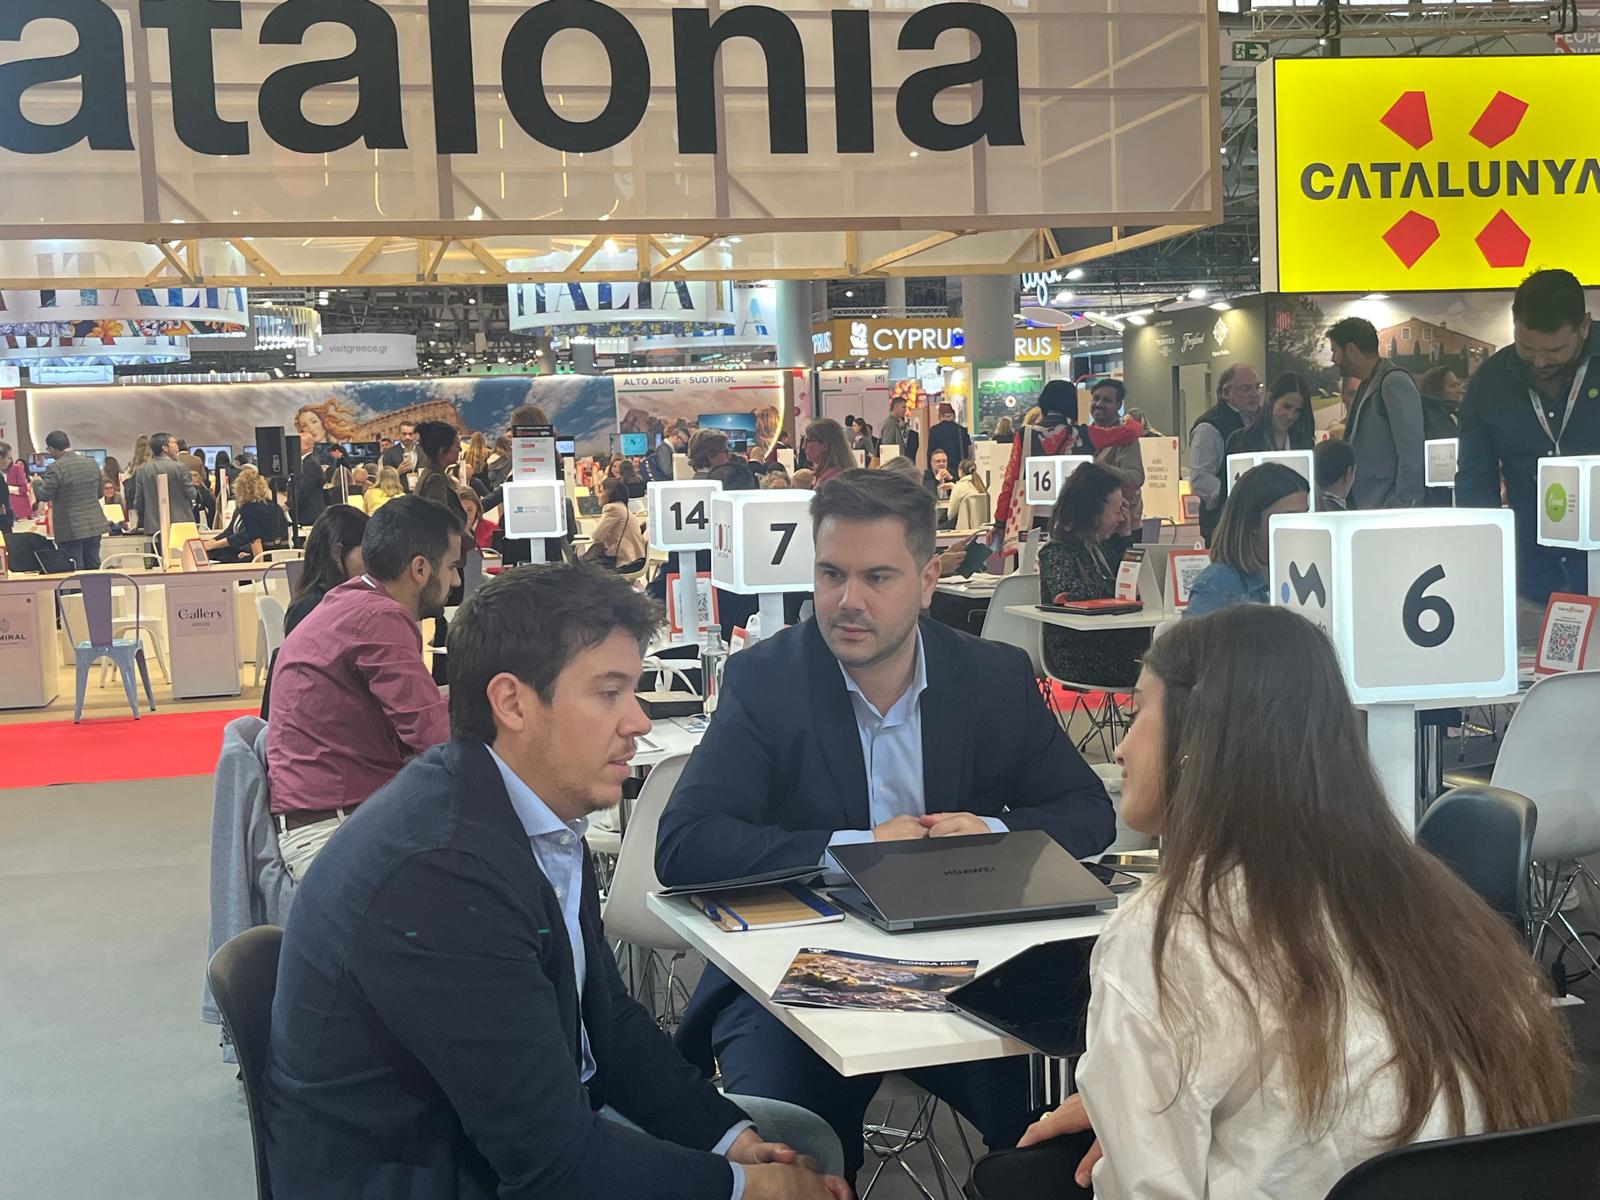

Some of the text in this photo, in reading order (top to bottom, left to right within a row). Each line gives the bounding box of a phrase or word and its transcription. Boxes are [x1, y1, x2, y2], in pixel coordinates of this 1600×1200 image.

[0, 0, 1024, 156] atalonia
[1300, 158, 1600, 201] CATALUNYA
[329, 344, 388, 354] visitgreece.gr
[873, 327, 964, 351] CYPRUS
[623, 377, 649, 386] ALTO
[652, 376, 681, 385] ADIGE
[1033, 470, 1051, 491] 16
[670, 500, 709, 531] 14
[770, 523, 798, 566] 7
[178, 608, 222, 620] Gallery
[1402, 564, 1455, 648] 6
